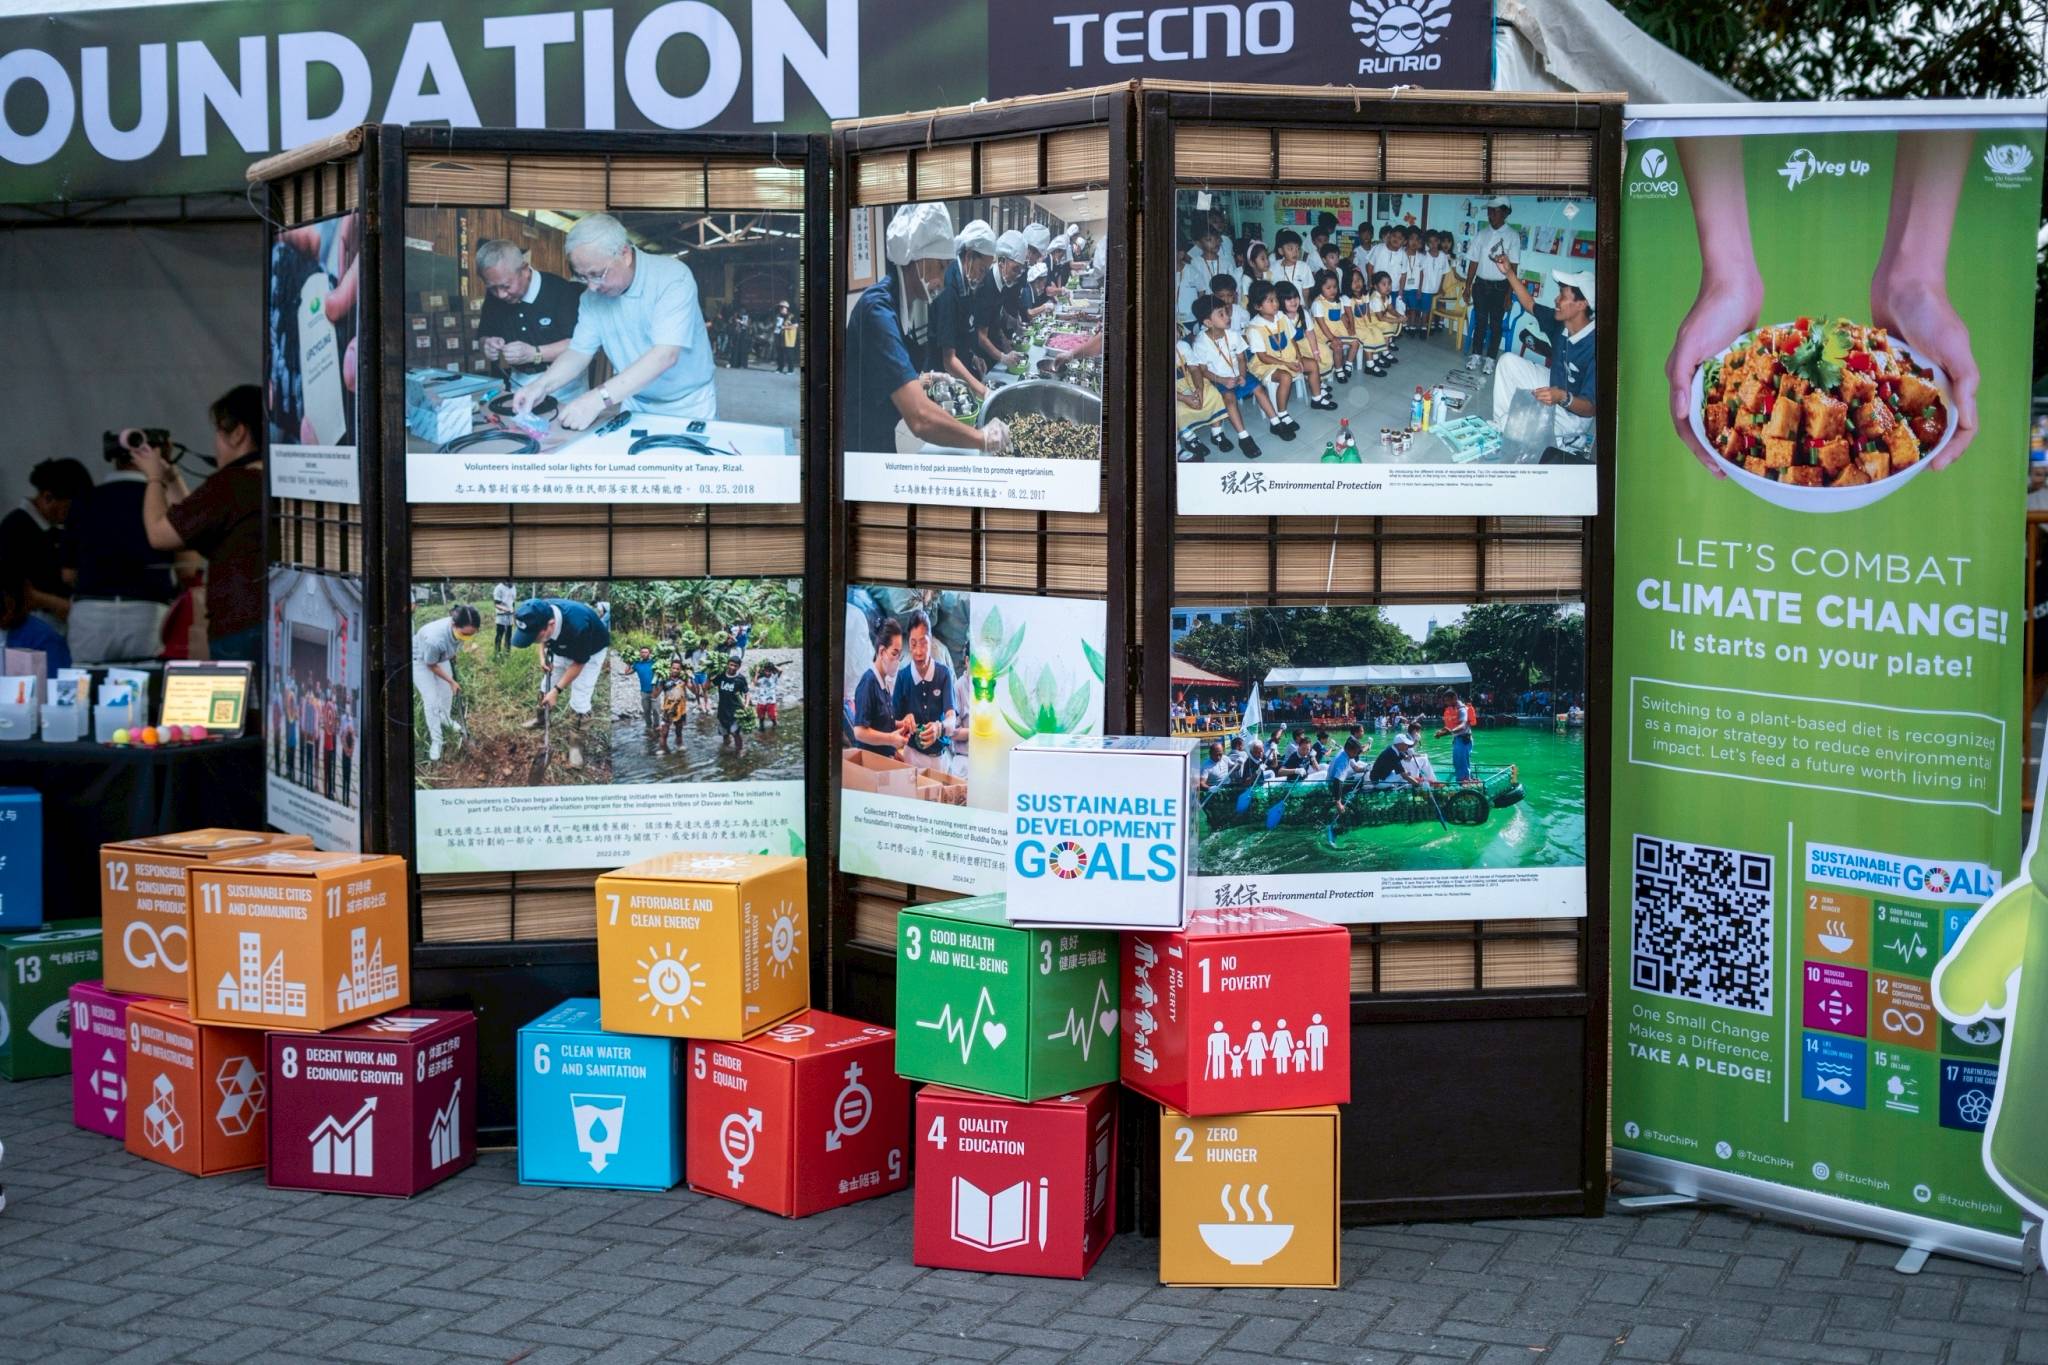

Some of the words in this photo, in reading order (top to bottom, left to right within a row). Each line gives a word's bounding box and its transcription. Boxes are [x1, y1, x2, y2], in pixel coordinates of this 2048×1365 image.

[1054, 0, 1294, 67] TECNO
[1359, 54, 1441, 75] RUNRIO
[1816, 161, 1845, 176] Veg
[1850, 160, 1869, 175] Up
[1629, 180, 1678, 196] proveg
[465, 463, 509, 472] Volunteers
[511, 462, 546, 472] installed
[548, 462, 567, 472] solar
[570, 462, 592, 474] lights
[594, 462, 606, 472] for
[609, 463, 635, 472] Lumad
[638, 464, 683, 474] community
[685, 464, 693, 472] at
[695, 463, 720, 474] Tanay,
[723, 463, 744, 472] Rizal.
[886, 462, 913, 471] Volunteers
[921, 464, 932, 472] food
[933, 464, 946, 473] pack
[947, 465, 971, 474] assembly
[991, 467, 1013, 476] promote
[1015, 468, 1054, 477] vegetarianism.
[699, 483, 755, 495] 03.25.2018
[1221, 471, 1268, 495] 環保
[1269, 479, 1335, 491] Environmental
[1336, 480, 1382, 491] Protection
[1008, 489, 1045, 500] 08.22.2017
[1677, 538, 1776, 573] LET'S
[1791, 547, 1971, 586] COMBAT
[1636, 578, 1802, 624] CLIMATE
[1816, 595, 2009, 645] CHANGE!
[1670, 629, 1686, 650] It
[1694, 633, 1766, 660] starts
[1775, 643, 1808, 663] on
[1818, 647, 1878, 671] your
[1887, 651, 1973, 678] plate!
[720, 681, 735, 692] Lee
[1642, 696, 1710, 720] Switching
[1736, 711, 1744, 722] a
[1750, 711, 1846, 734] plant-based
[1852, 722, 1882, 738] diet
[1905, 728, 1995, 752] recognized
[1644, 717, 1659, 730] as
[1675, 722, 1718, 740] major
[1723, 728, 1786, 749] strategy
[1815, 738, 1870, 758] reduce
[1875, 745, 1992, 771] environmental
[1652, 738, 1705, 759] impact.
[1711, 745, 1746, 763] Let's
[1751, 750, 1785, 768] feed
[1806, 756, 1855, 776] future
[1860, 763, 1906, 784] worth
[1912, 770, 1962, 790] living
[1968, 774, 1987, 790] in!
[1017, 793, 1176, 817] SUSTAINABLE
[864, 807, 887, 817] Collected
[899, 812, 915, 820] bottles
[934, 818, 952, 829] running
[978, 825, 990, 833] used
[998, 827, 1008, 836] mak
[864, 817, 893, 828] foundation's
[894, 821, 917, 833] upcoming
[935, 828, 962, 839] celebration
[970, 834, 990, 844] Buddha
[1016, 817, 1176, 839] DEVELOPMENT
[135, 864, 185, 879] RESPONSIBLE
[1015, 840, 1176, 883] GOALS
[1812, 849, 1901, 875] SUSTAINABLE
[106, 861, 129, 891] 12
[1811, 863, 1900, 888] DEVELOPMENT
[136, 881, 185, 897] CONSUMPTIO
[200, 883, 222, 914] 11
[227, 884, 284, 900] SUSTAINABLE
[285, 888, 312, 902] CITIES
[1215, 884, 1260, 906] 環保
[1262, 890, 1327, 901] Environmental
[1329, 889, 1374, 900] Protection
[137, 899, 153, 911] AND
[154, 900, 186, 914] PRODUC
[248, 904, 308, 920] COMMUNITIES
[326, 886, 341, 919] 11
[606, 894, 620, 926] 7
[630, 896, 690, 911] AFFORDABLE
[692, 899, 713, 912] AND
[631, 914, 662, 927] CLEAN
[663, 915, 700, 929] ENERGY
[906, 925, 921, 961] 3
[930, 929, 957, 946] GOOD
[959, 934, 994, 952] HEALTH
[1060, 935, 1078, 952] 良好
[50, 950, 98, 966] 气候行动
[930, 950, 949, 966] AND
[952, 952, 1008, 975] WELL-BEING
[1040, 940, 1052, 976] 3
[1059, 949, 1107, 972] 健康与福祉
[1168, 945, 1183, 960] 1
[1221, 956, 1237, 971] NO
[15, 955, 42, 984] 13
[1176, 970, 1184, 988] NO
[1198, 958, 1211, 993] 1
[1807, 966, 1820, 982] 10
[1221, 974, 1271, 992] POVERTY
[1875, 979, 1889, 994] 12
[1169, 967, 1177, 1023] POVERTY
[73, 1000, 89, 1031] 10
[745, 1005, 760, 1021] 7
[1632, 1004, 1661, 1022] One
[1666, 1011, 1706, 1030] Small
[1711, 1020, 1770, 1042] Change
[130, 1022, 140, 1052] 9
[1629, 1022, 1672, 1043] Makes
[1678, 1034, 1686, 1045] a
[1691, 1035, 1773, 1063] Difference.
[1806, 1038, 1819, 1053] 14
[306, 1048, 342, 1063] DECENT
[344, 1051, 374, 1065] WORK
[376, 1053, 397, 1066] AND
[534, 1043, 550, 1074] 6
[561, 1044, 593, 1058] CLEAN
[598, 1045, 631, 1059] WATER
[713, 1052, 742, 1072] GENDER
[1874, 1051, 1887, 1067] 15
[282, 1047, 298, 1079] 8
[417, 1050, 425, 1082] 8
[562, 1063, 583, 1075] AND
[586, 1064, 646, 1079] SANITATION
[694, 1048, 706, 1080] 5
[1628, 1042, 1671, 1064] TAKE
[1677, 1054, 1689, 1068] A
[1696, 1057, 1771, 1084] PLEDGE!
[1946, 1065, 1959, 1081] 17
[306, 1066, 358, 1082] ECONOMIC
[360, 1070, 403, 1085] GROWTH
[713, 1071, 747, 1092] EQUALITY
[927, 1115, 947, 1150] 4
[959, 1117, 1008, 1135] QUALITY
[1207, 1127, 1238, 1142] ZERO
[959, 1137, 1025, 1156] EDUCATION
[1174, 1127, 1194, 1162] 2
[1643, 1127, 1699, 1149] @TzuChiPH
[1207, 1148, 1257, 1162] HUNGER
[1737, 1148, 1794, 1170] @TzuChiPH
[1835, 1170, 1890, 1192] @tzuchiph
